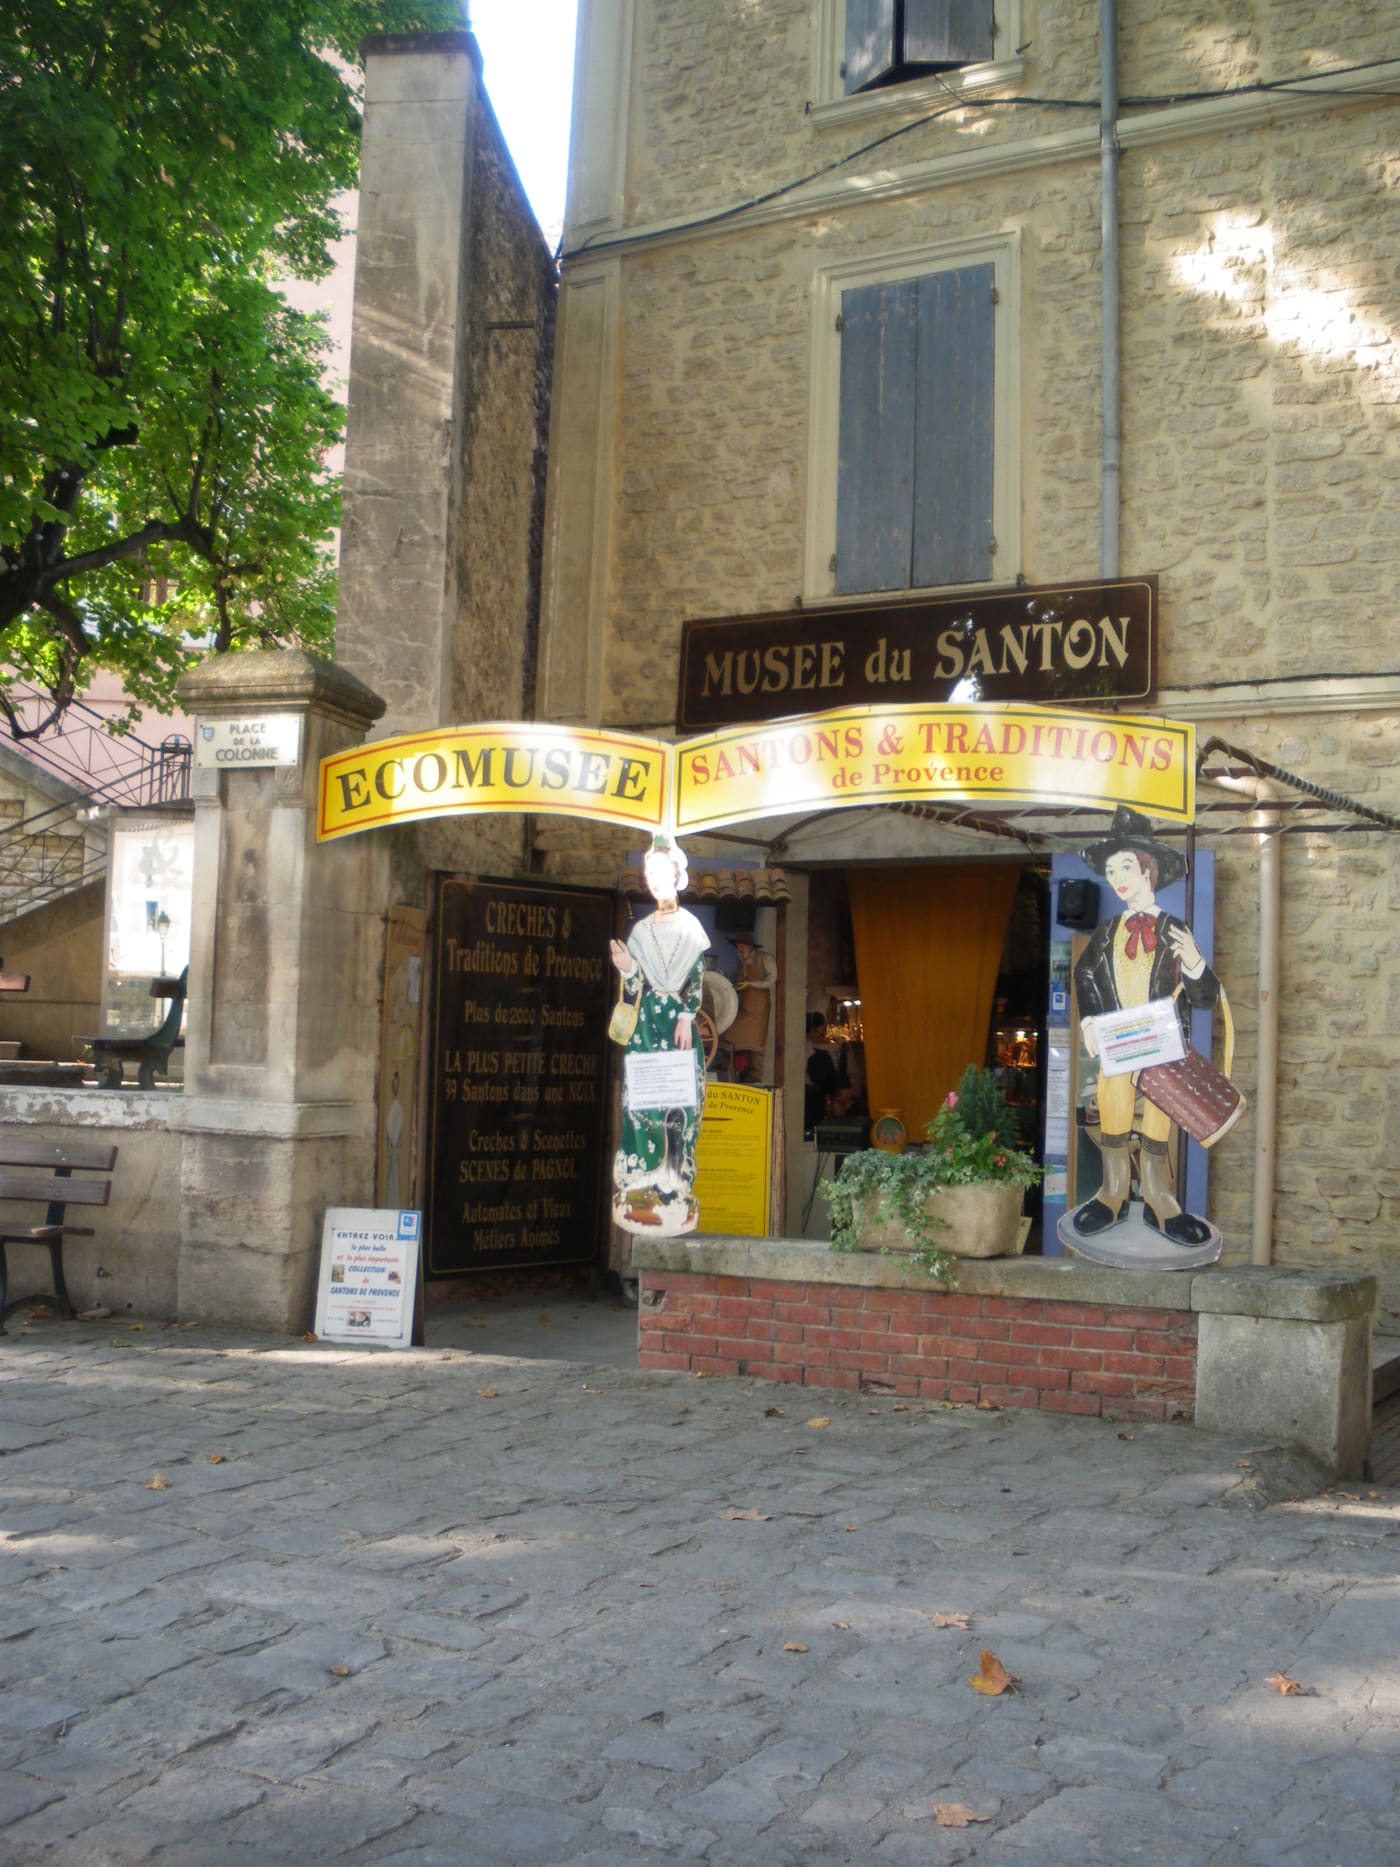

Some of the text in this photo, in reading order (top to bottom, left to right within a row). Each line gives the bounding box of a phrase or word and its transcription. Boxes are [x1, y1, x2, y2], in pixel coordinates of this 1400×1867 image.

[701, 616, 1132, 698] MUSEE du SANTON
[229, 723, 267, 735] PLACE
[233, 737, 262, 746] DE LA
[215, 746, 280, 762] COLONNE
[690, 722, 1174, 787] SANTONS & TRADITIONS
[335, 747, 651, 813] ECOMUSEE
[831, 763, 1005, 789] de Provence
[485, 901, 556, 939] CRECHES
[446, 938, 603, 981] Traditions de Provence
[464, 1000, 491, 1024] Plus
[494, 1002, 508, 1025] de
[540, 1003, 585, 1028] Santons
[445, 1050, 599, 1075] LA PLUS PETITE CRECHE
[462, 1077, 510, 1104] Santons
[512, 1080, 541, 1105] dans
[720, 1090, 761, 1106] SANTON
[719, 1101, 755, 1115] Provence
[458, 1157, 577, 1184] SCENES de PAGNOL
[461, 1199, 523, 1225] Automates
[526, 1198, 538, 1221] et
[337, 1231, 394, 1241] ENTREZ VOIR
[348, 1265, 386, 1273] COLLECTION
[330, 1286, 401, 1298] SANTONS DE PROVENCE
